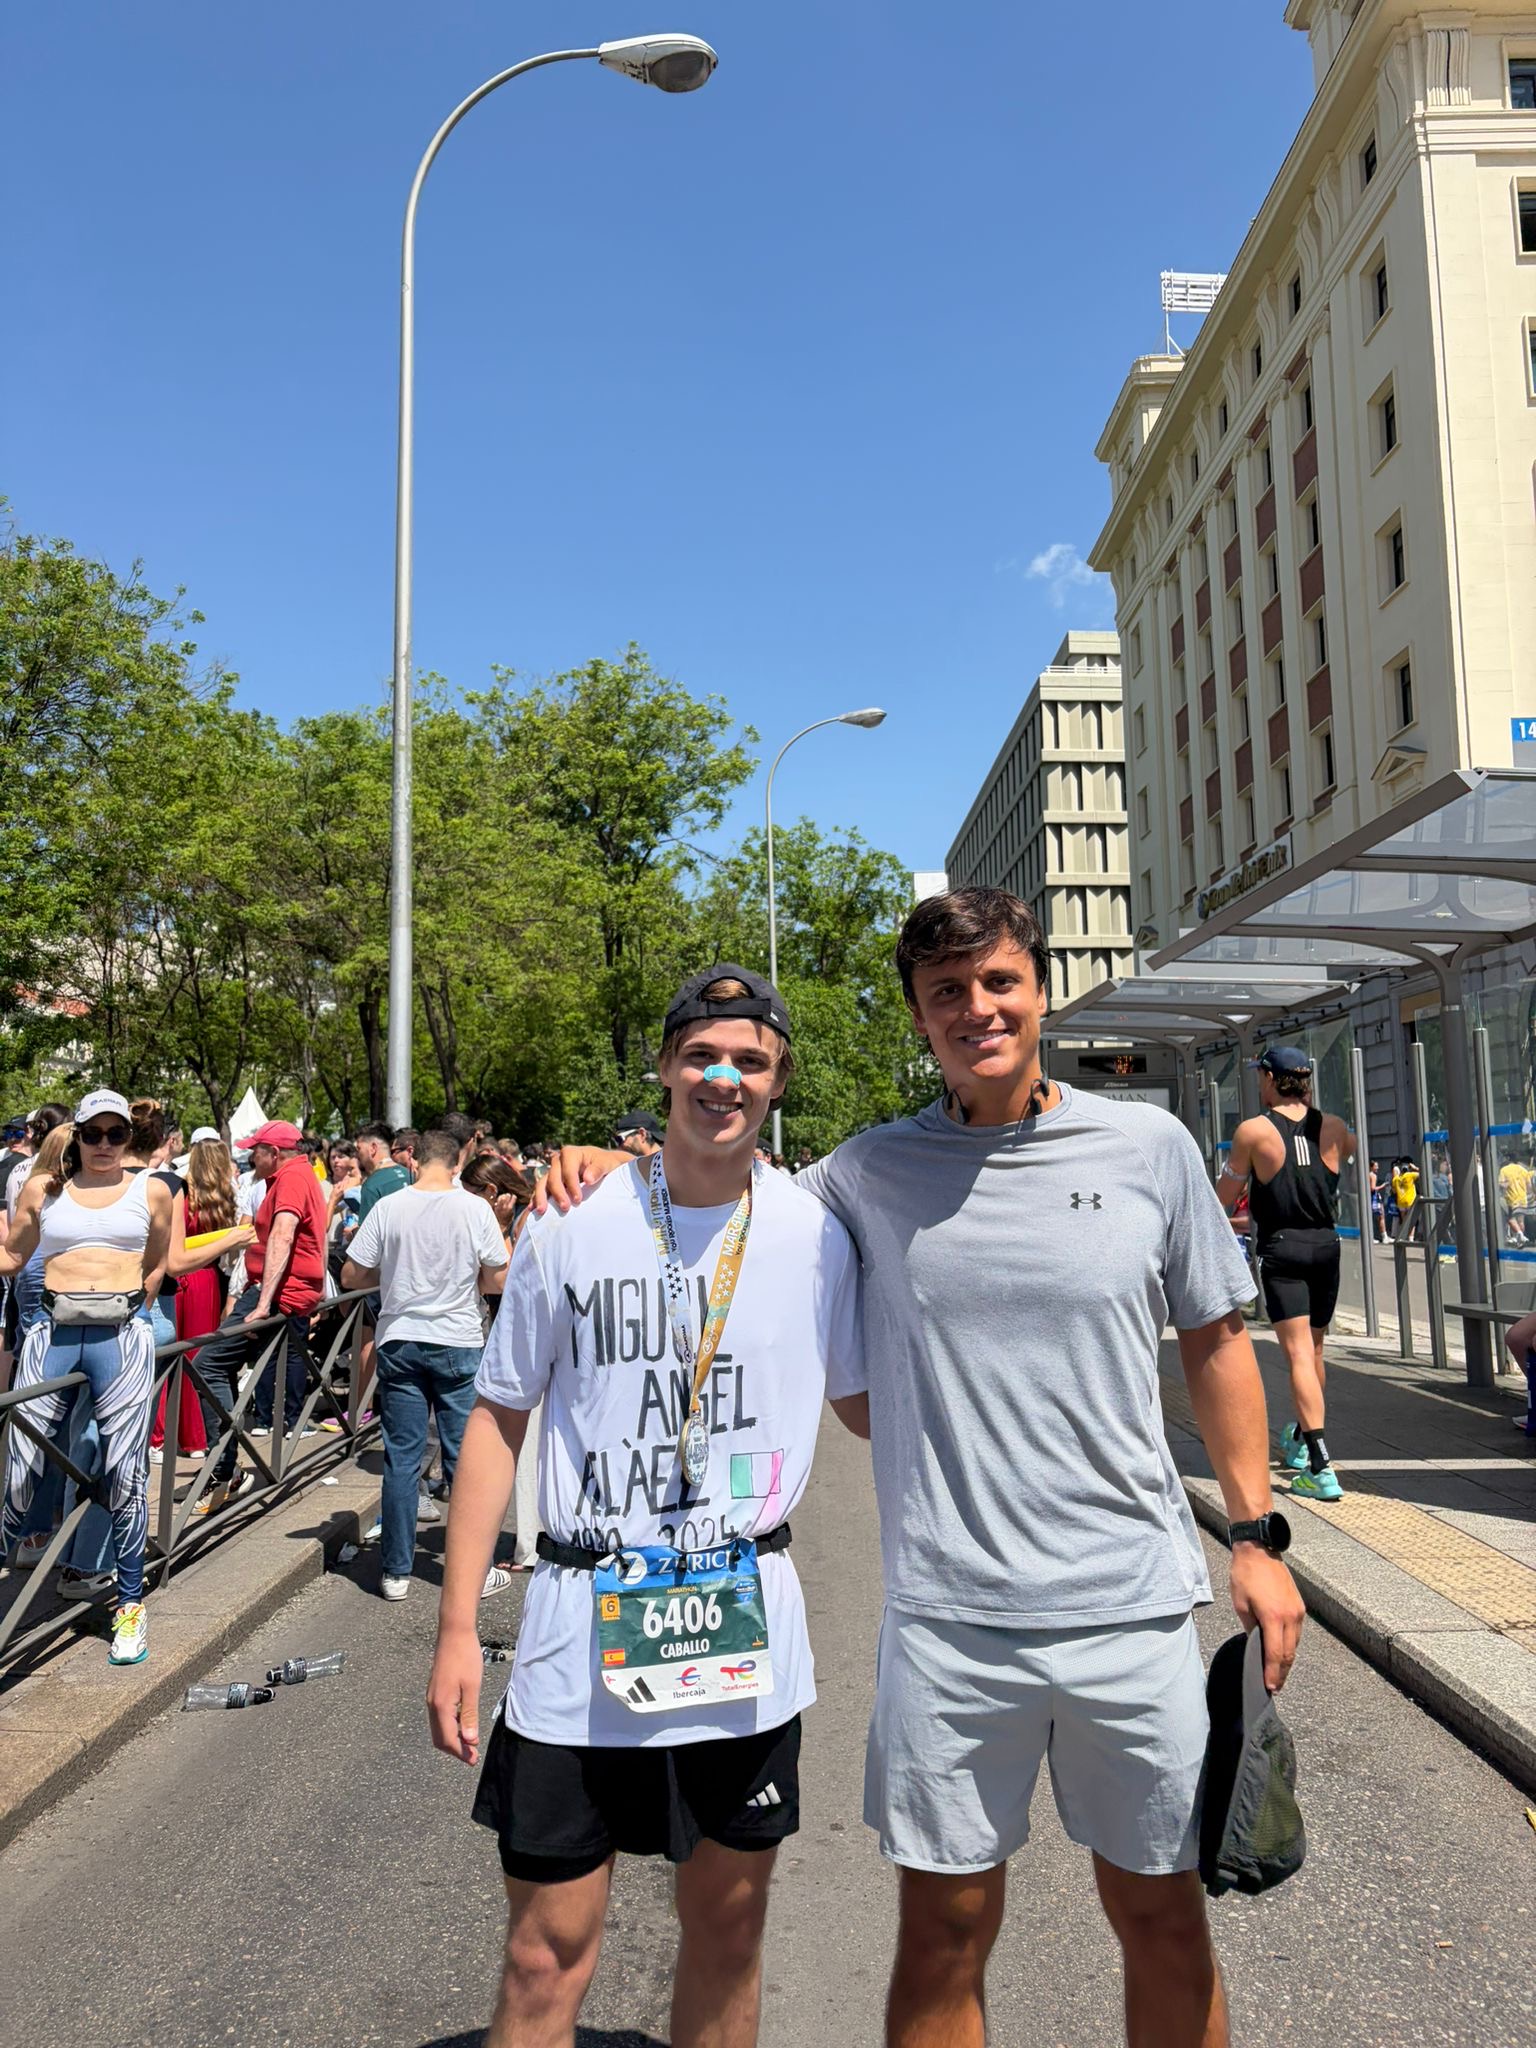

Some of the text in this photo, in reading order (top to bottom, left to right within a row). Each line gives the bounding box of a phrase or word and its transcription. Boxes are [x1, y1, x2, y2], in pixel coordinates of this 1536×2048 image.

[564, 1275, 733, 1368] MIGUL
[606, 1600, 616, 1612] 6
[643, 1593, 723, 1638] 6406
[660, 1638, 710, 1659] CABALLO
[672, 1687, 706, 1699] Ibercaja
[721, 1682, 760, 1692] TotalEnergies
